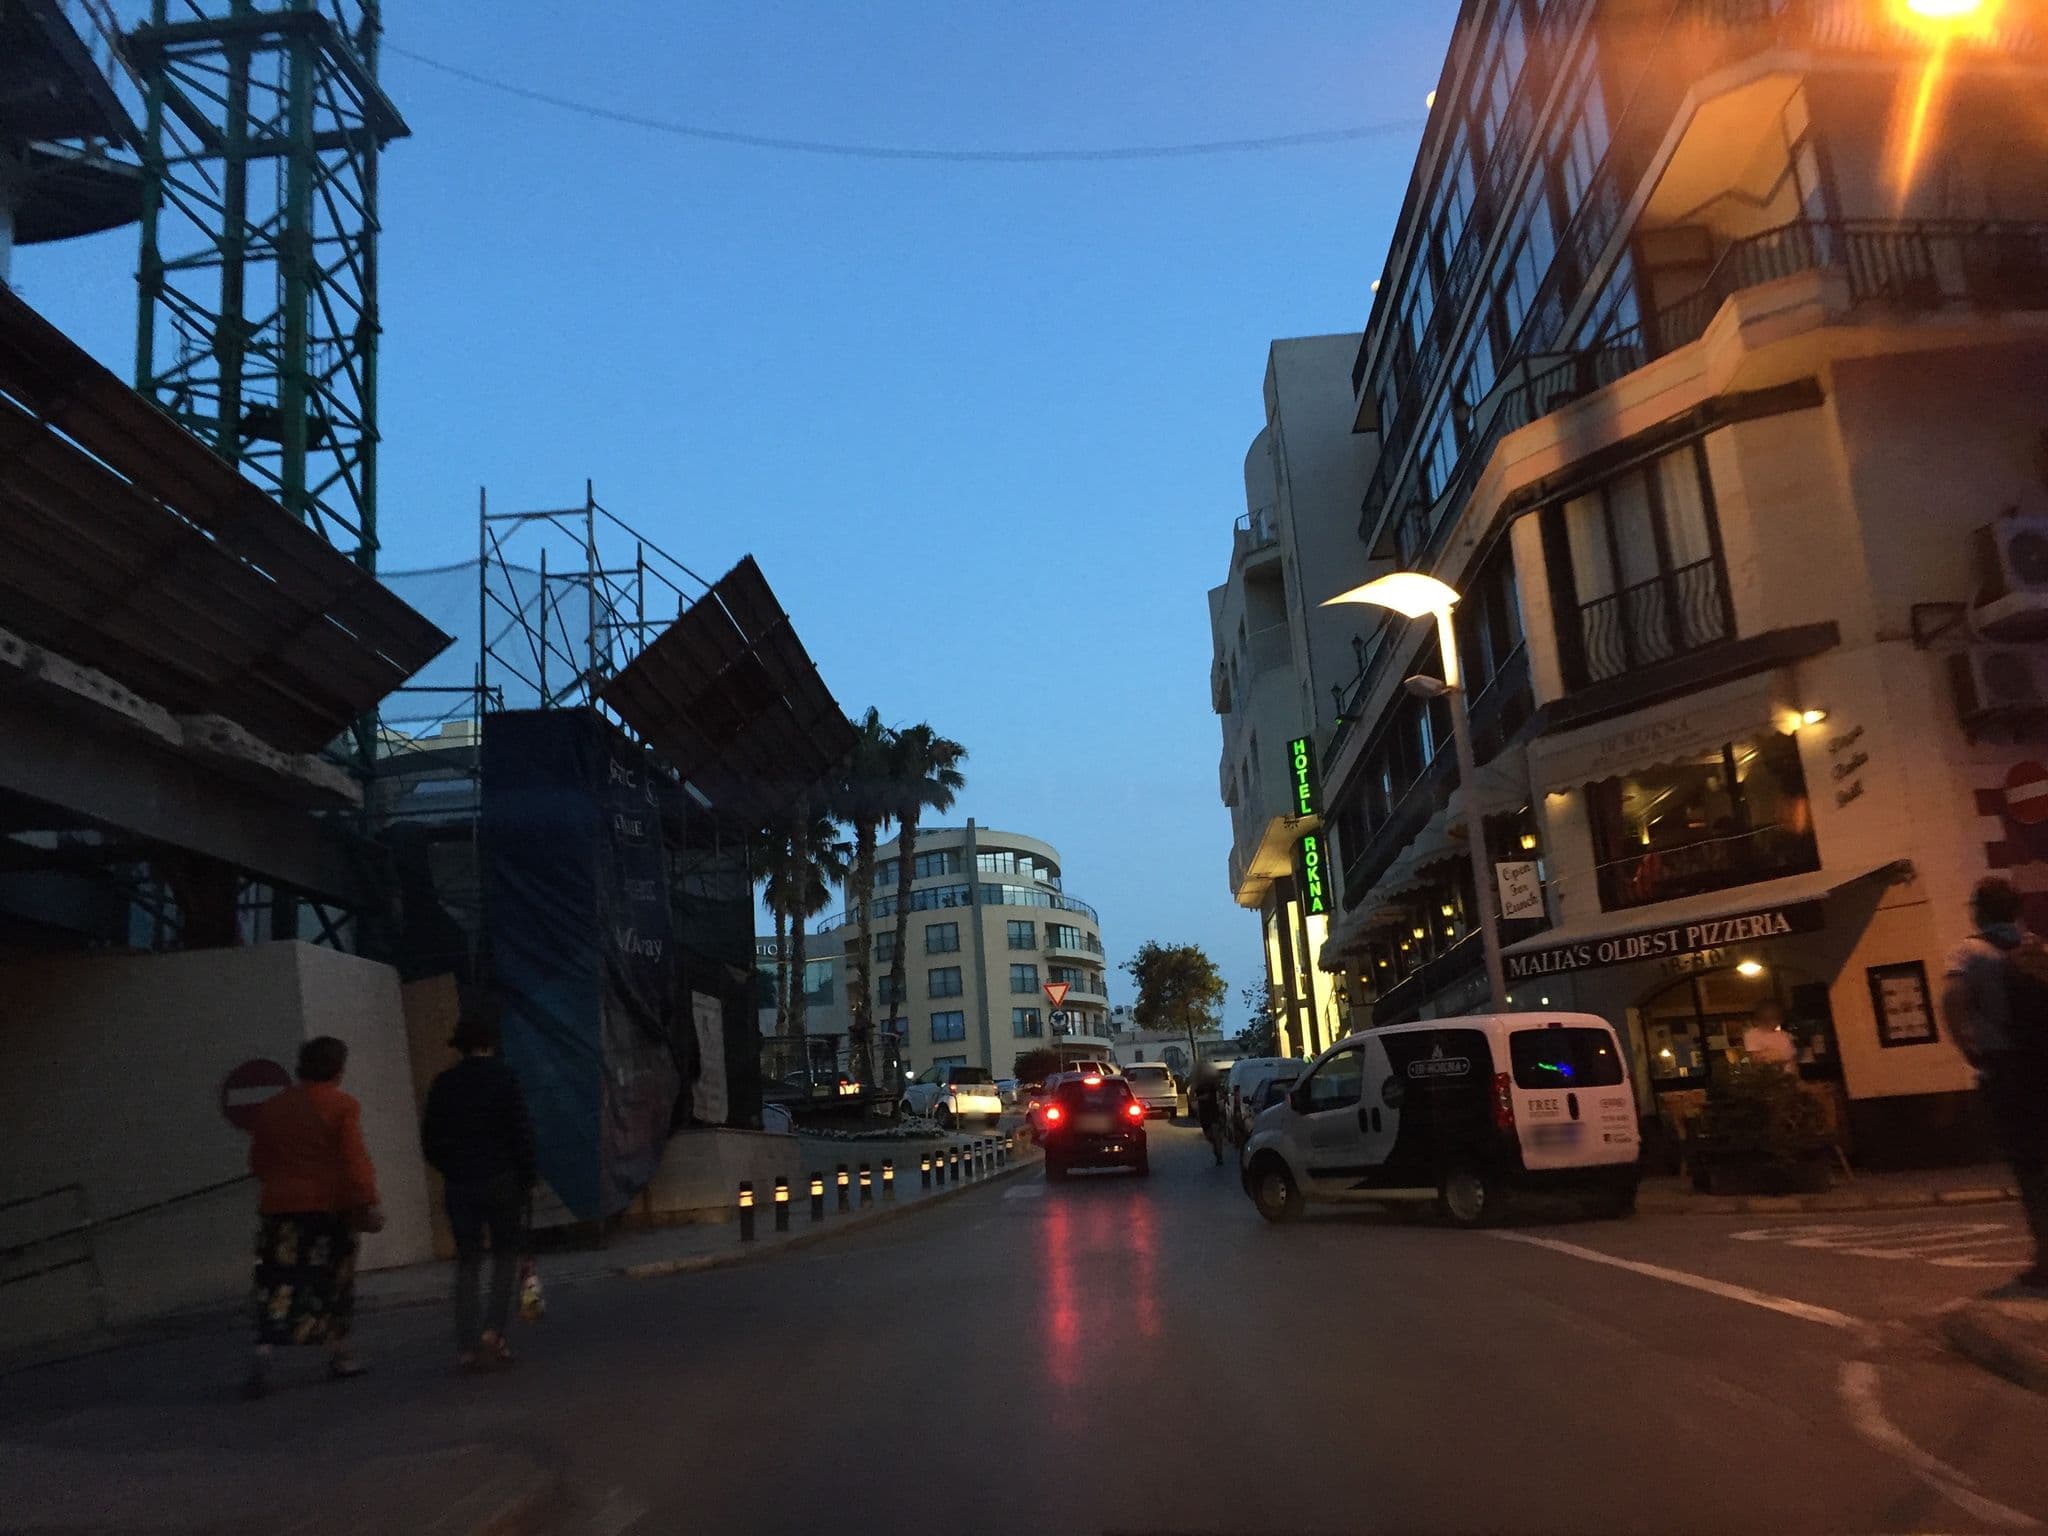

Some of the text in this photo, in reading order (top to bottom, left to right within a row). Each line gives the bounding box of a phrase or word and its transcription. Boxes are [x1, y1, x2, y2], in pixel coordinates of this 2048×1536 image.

[1293, 738, 1313, 815] HOTEL
[1303, 836, 1324, 913] ROKNA
[1509, 911, 1793, 978] MALTA'S OLDEST PIZZERIA
[1527, 1098, 1560, 1111] FREE
